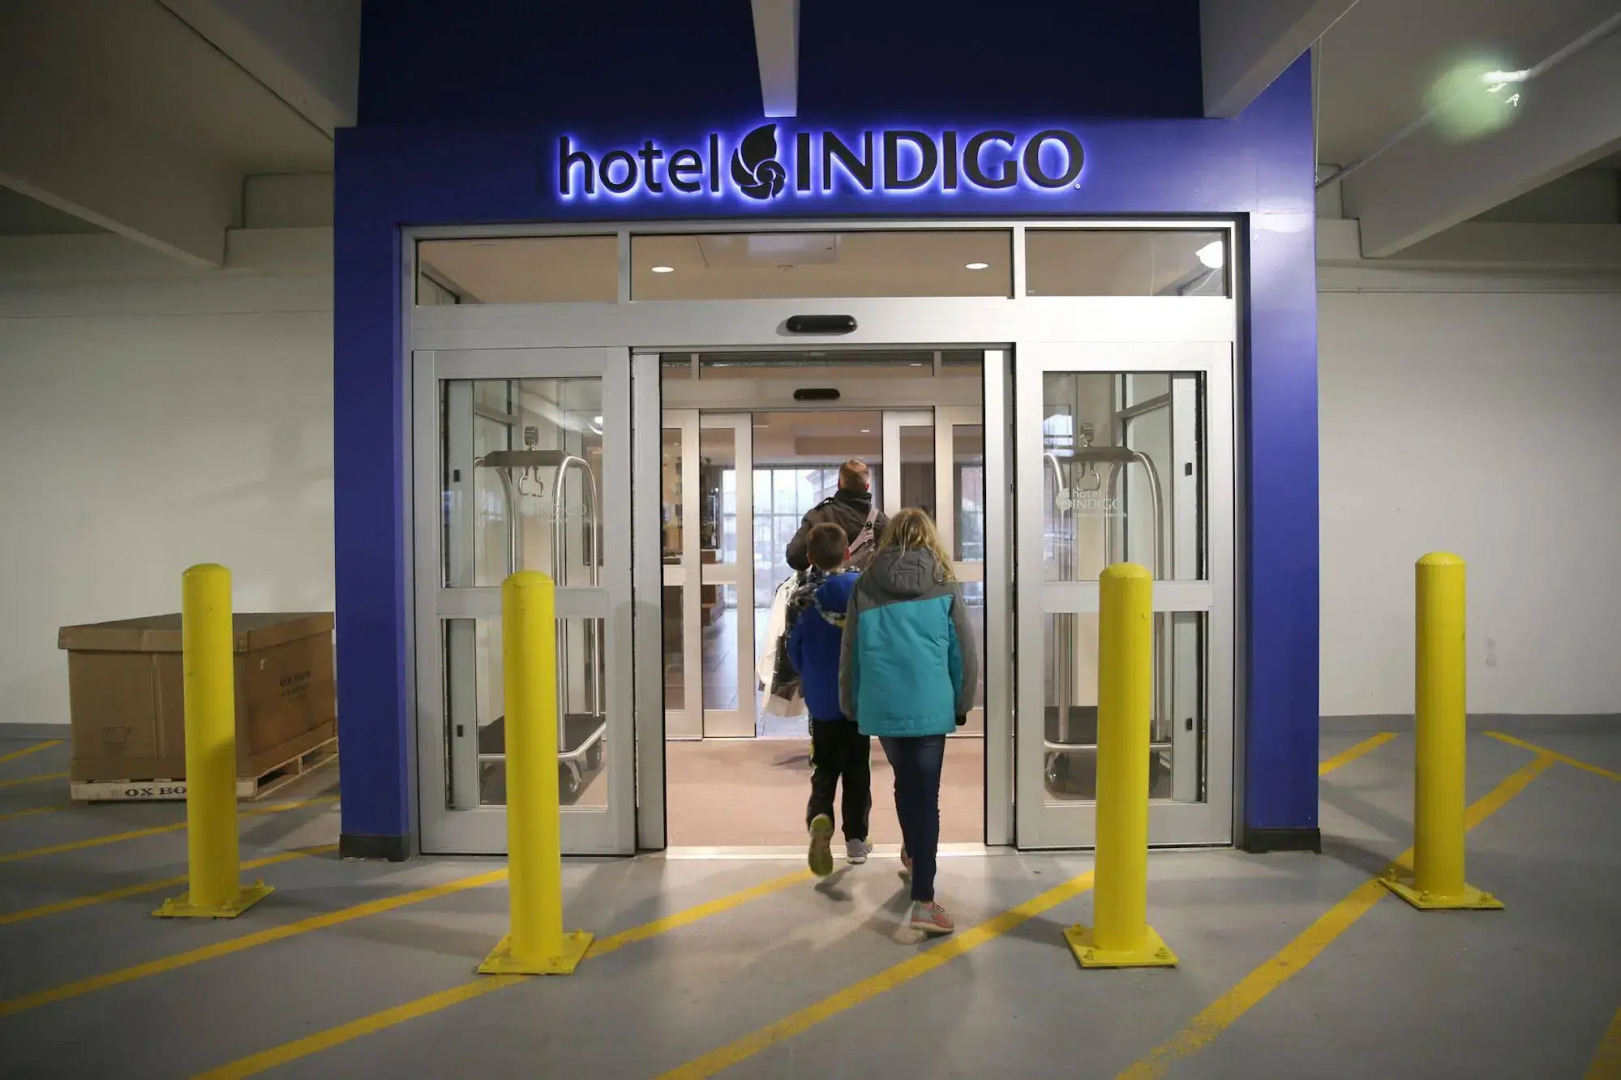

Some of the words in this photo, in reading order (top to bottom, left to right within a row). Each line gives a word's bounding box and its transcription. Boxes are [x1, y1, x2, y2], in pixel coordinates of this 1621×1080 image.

[559, 133, 719, 195] hotel
[796, 129, 1085, 192] INDIGO
[1072, 487, 1101, 498] hotel
[1072, 498, 1119, 510] INDIGO
[125, 787, 154, 797] OX
[159, 785, 187, 795] BO
